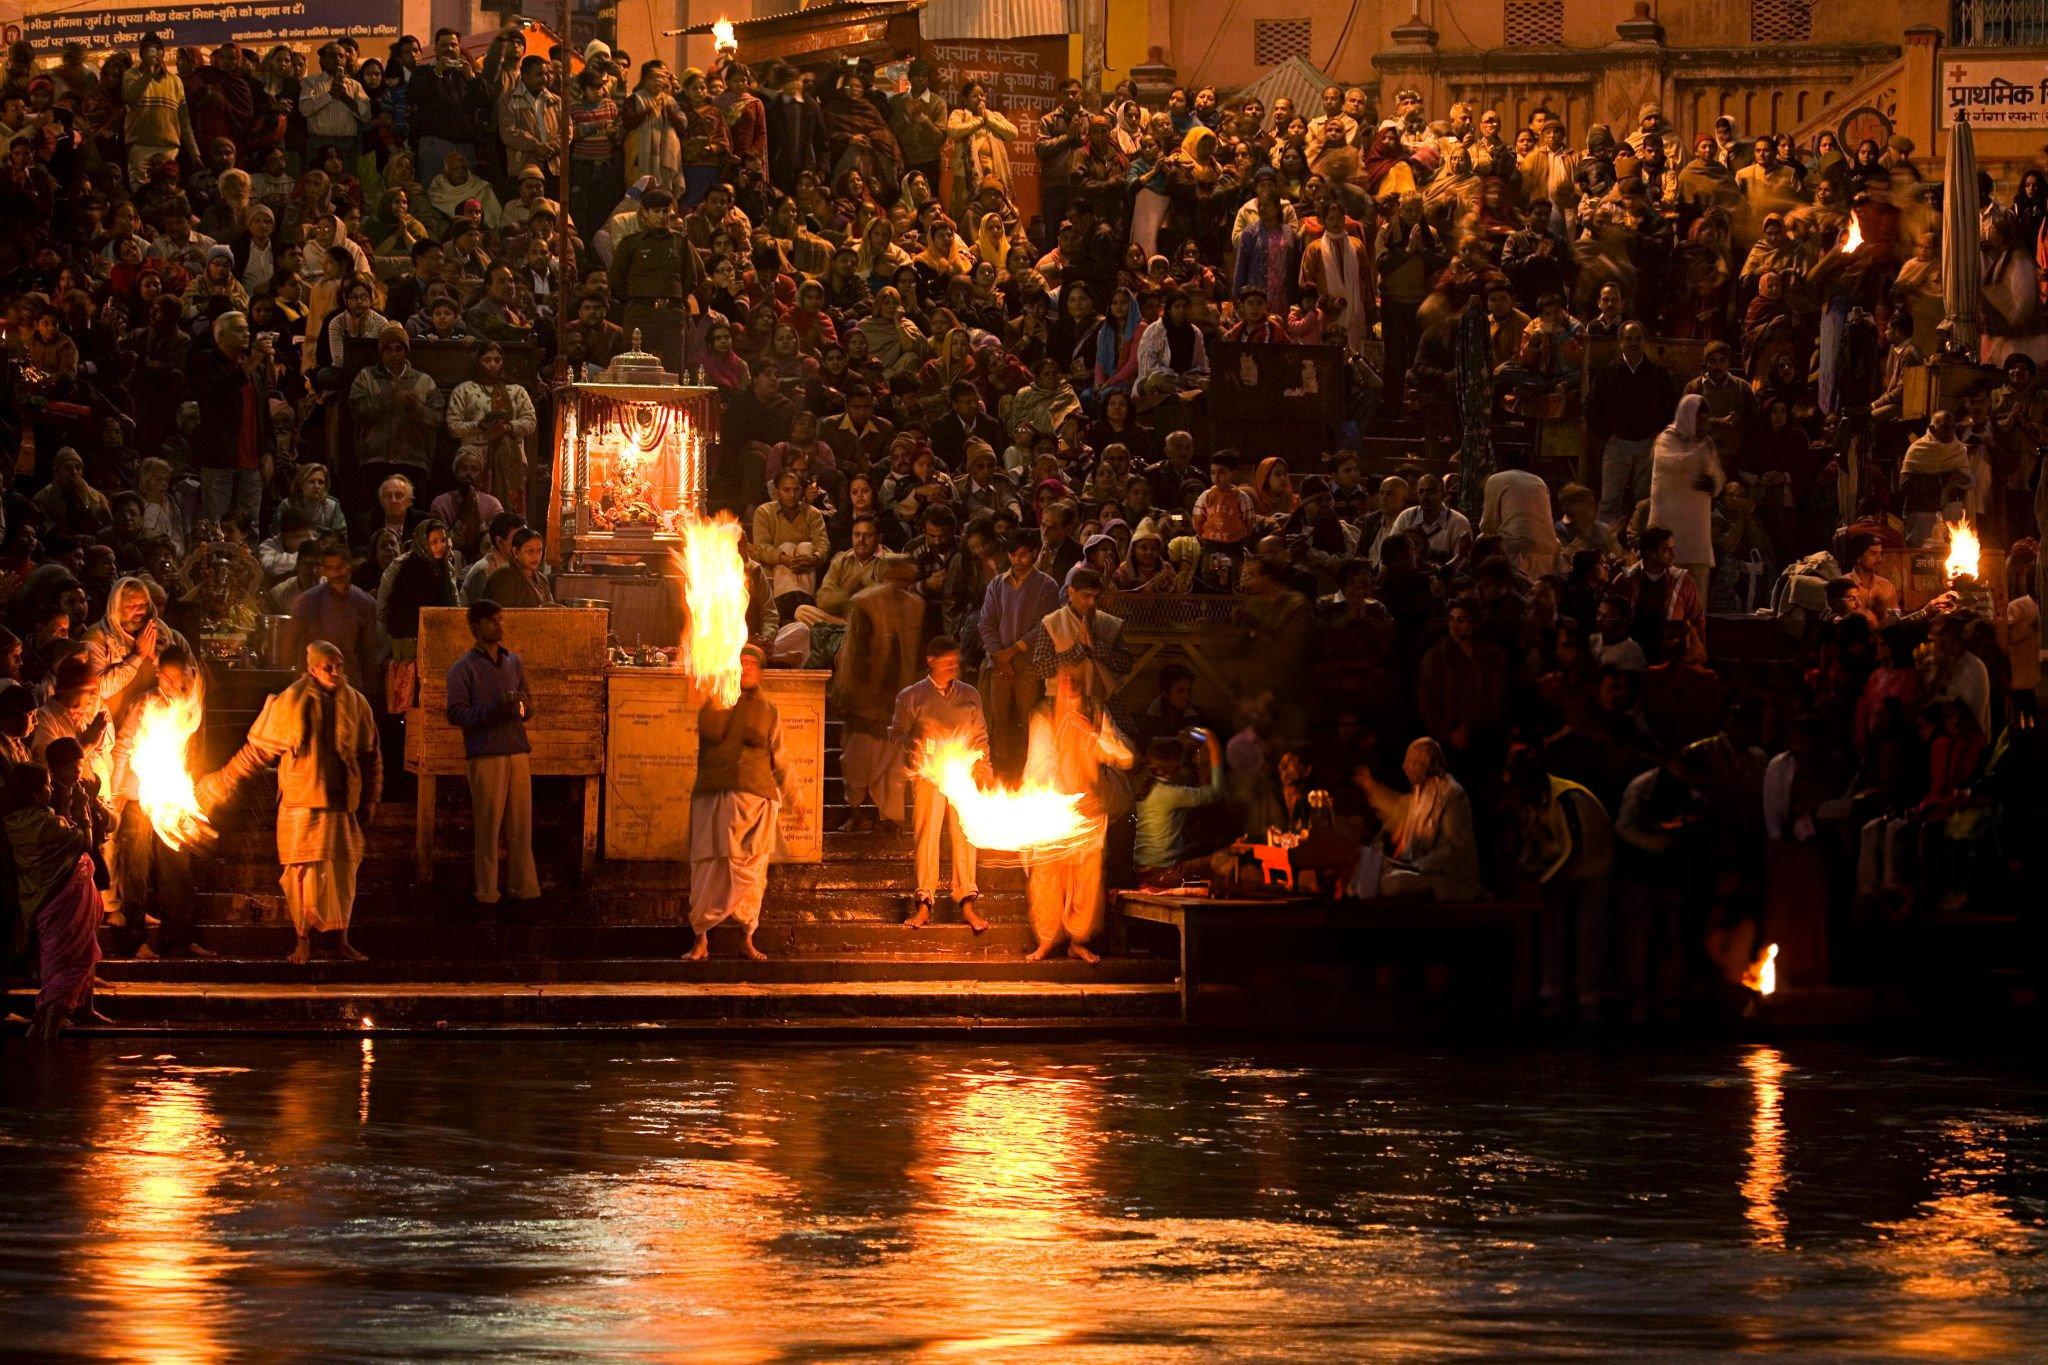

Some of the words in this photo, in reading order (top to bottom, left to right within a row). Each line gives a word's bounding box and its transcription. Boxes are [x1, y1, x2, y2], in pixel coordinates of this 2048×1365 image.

[239, 6, 252, 17] को
[1947, 77, 2034, 107] प्राथमिक
[1973, 108, 2006, 122] गंगा
